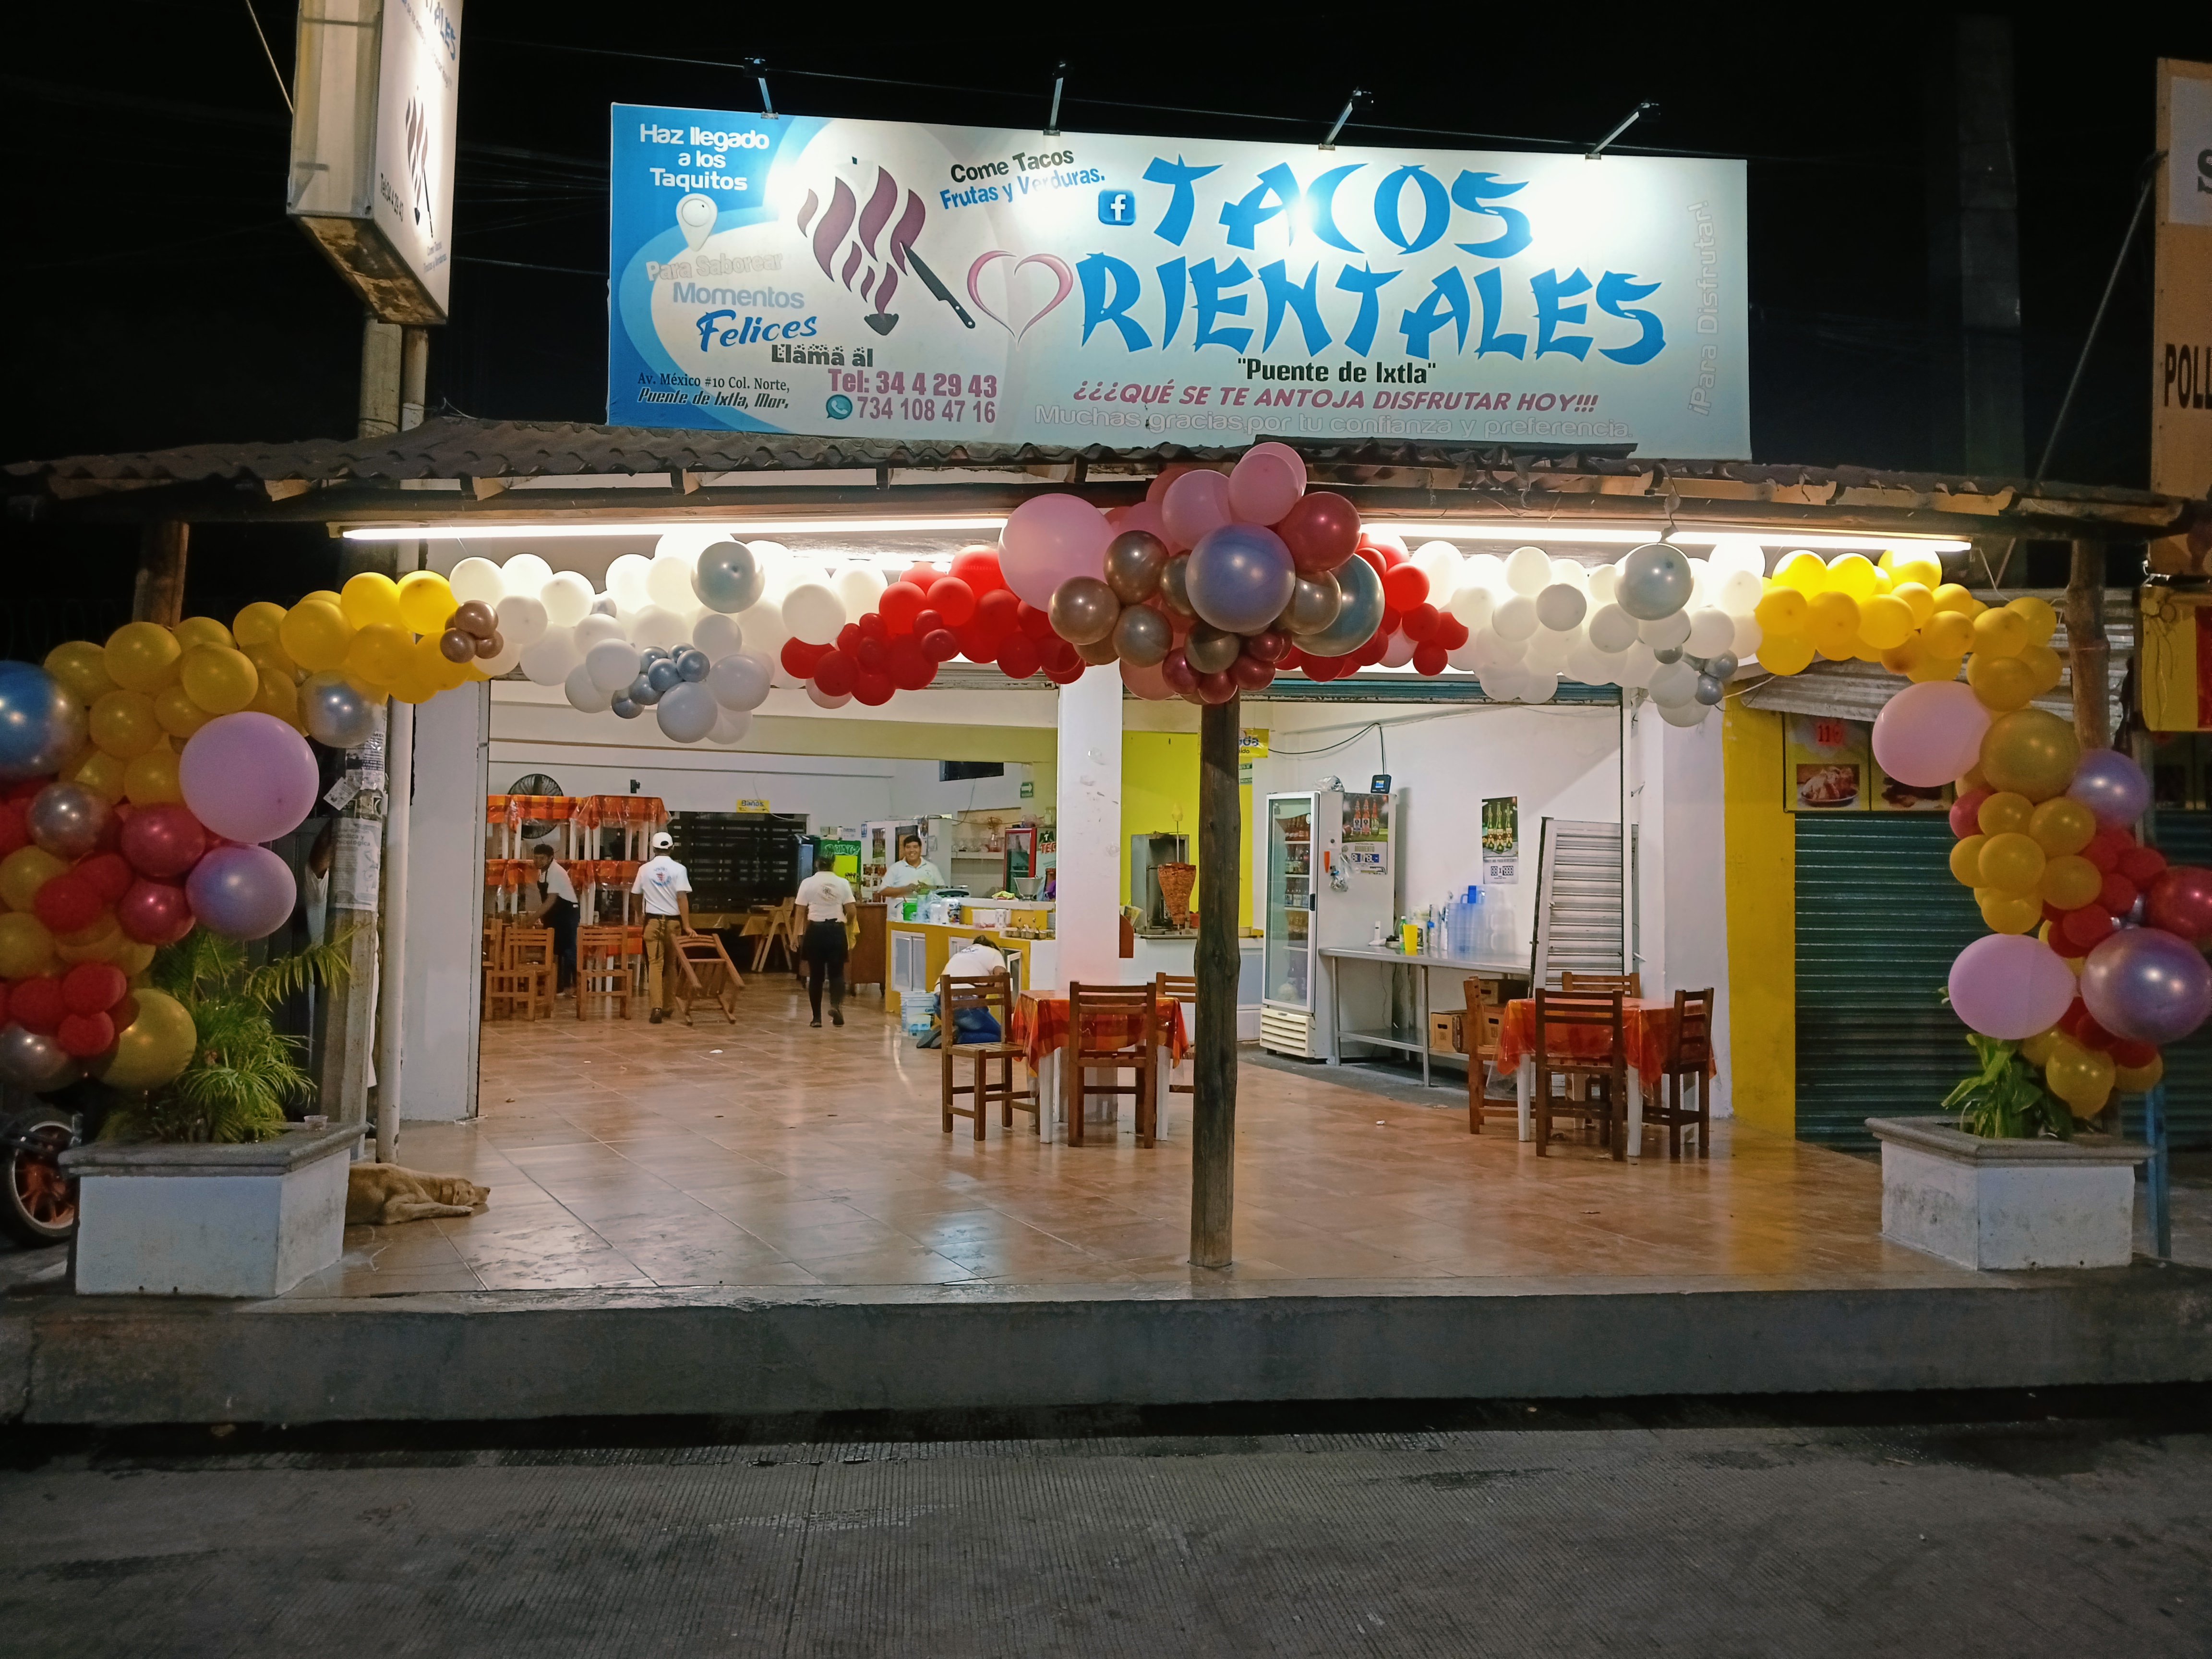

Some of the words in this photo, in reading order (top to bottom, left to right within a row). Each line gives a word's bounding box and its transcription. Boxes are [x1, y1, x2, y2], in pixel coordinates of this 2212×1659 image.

[640, 123, 684, 144] Haz
[690, 126, 769, 152] llegado
[678, 152, 691, 166] a
[696, 150, 726, 168] los
[950, 161, 1009, 183] Come
[1012, 150, 1074, 171] Tacos
[649, 167, 747, 192] Taquitos
[939, 186, 999, 210] Frutas
[1002, 183, 1013, 203] y
[1142, 154, 1533, 259] TACOS
[646, 260, 692, 282] Para
[696, 253, 783, 276] Saborear
[1686, 200, 1719, 335] Disfrutar!
[673, 282, 805, 309] Momentos
[696, 309, 817, 352] Felices
[771, 344, 845, 367] Llama
[852, 347, 873, 367] al
[637, 372, 656, 384] Av.
[660, 373, 701, 387] México
[705, 376, 725, 388] #10
[728, 377, 750, 389] Col.
[754, 377, 790, 393] Norte,
[828, 368, 870, 393] Tel:
[876, 371, 905, 395] 34
[912, 373, 926, 396] 4
[933, 373, 962, 397] 29
[968, 374, 997, 398] 43
[1238, 358, 1329, 382] "Puente
[1338, 361, 1367, 383] de
[1376, 361, 1436, 384] Ixtla"
[637, 387, 688, 404] Puente
[692, 390, 710, 405] de
[714, 391, 749, 409] Ixtla,
[754, 393, 789, 409] Mor.
[857, 396, 893, 420] 734
[901, 397, 935, 421] 108
[942, 399, 966, 422] 47
[973, 400, 996, 423] 16
[1073, 379, 1175, 404] ¿¿¿QUÉ
[1179, 386, 1212, 405] SE
[1220, 386, 1250, 406] TE
[1254, 388, 1364, 409] ANTOJA
[1372, 391, 1512, 410] DISFRUTAR
[1516, 393, 1599, 412] HOY!!!
[1035, 404, 1142, 427] Muchas
[1298, 413, 1323, 433] tu
[1329, 415, 1453, 434] confianza
[1460, 419, 1477, 438] y
[1484, 417, 1633, 438] preferencia.
